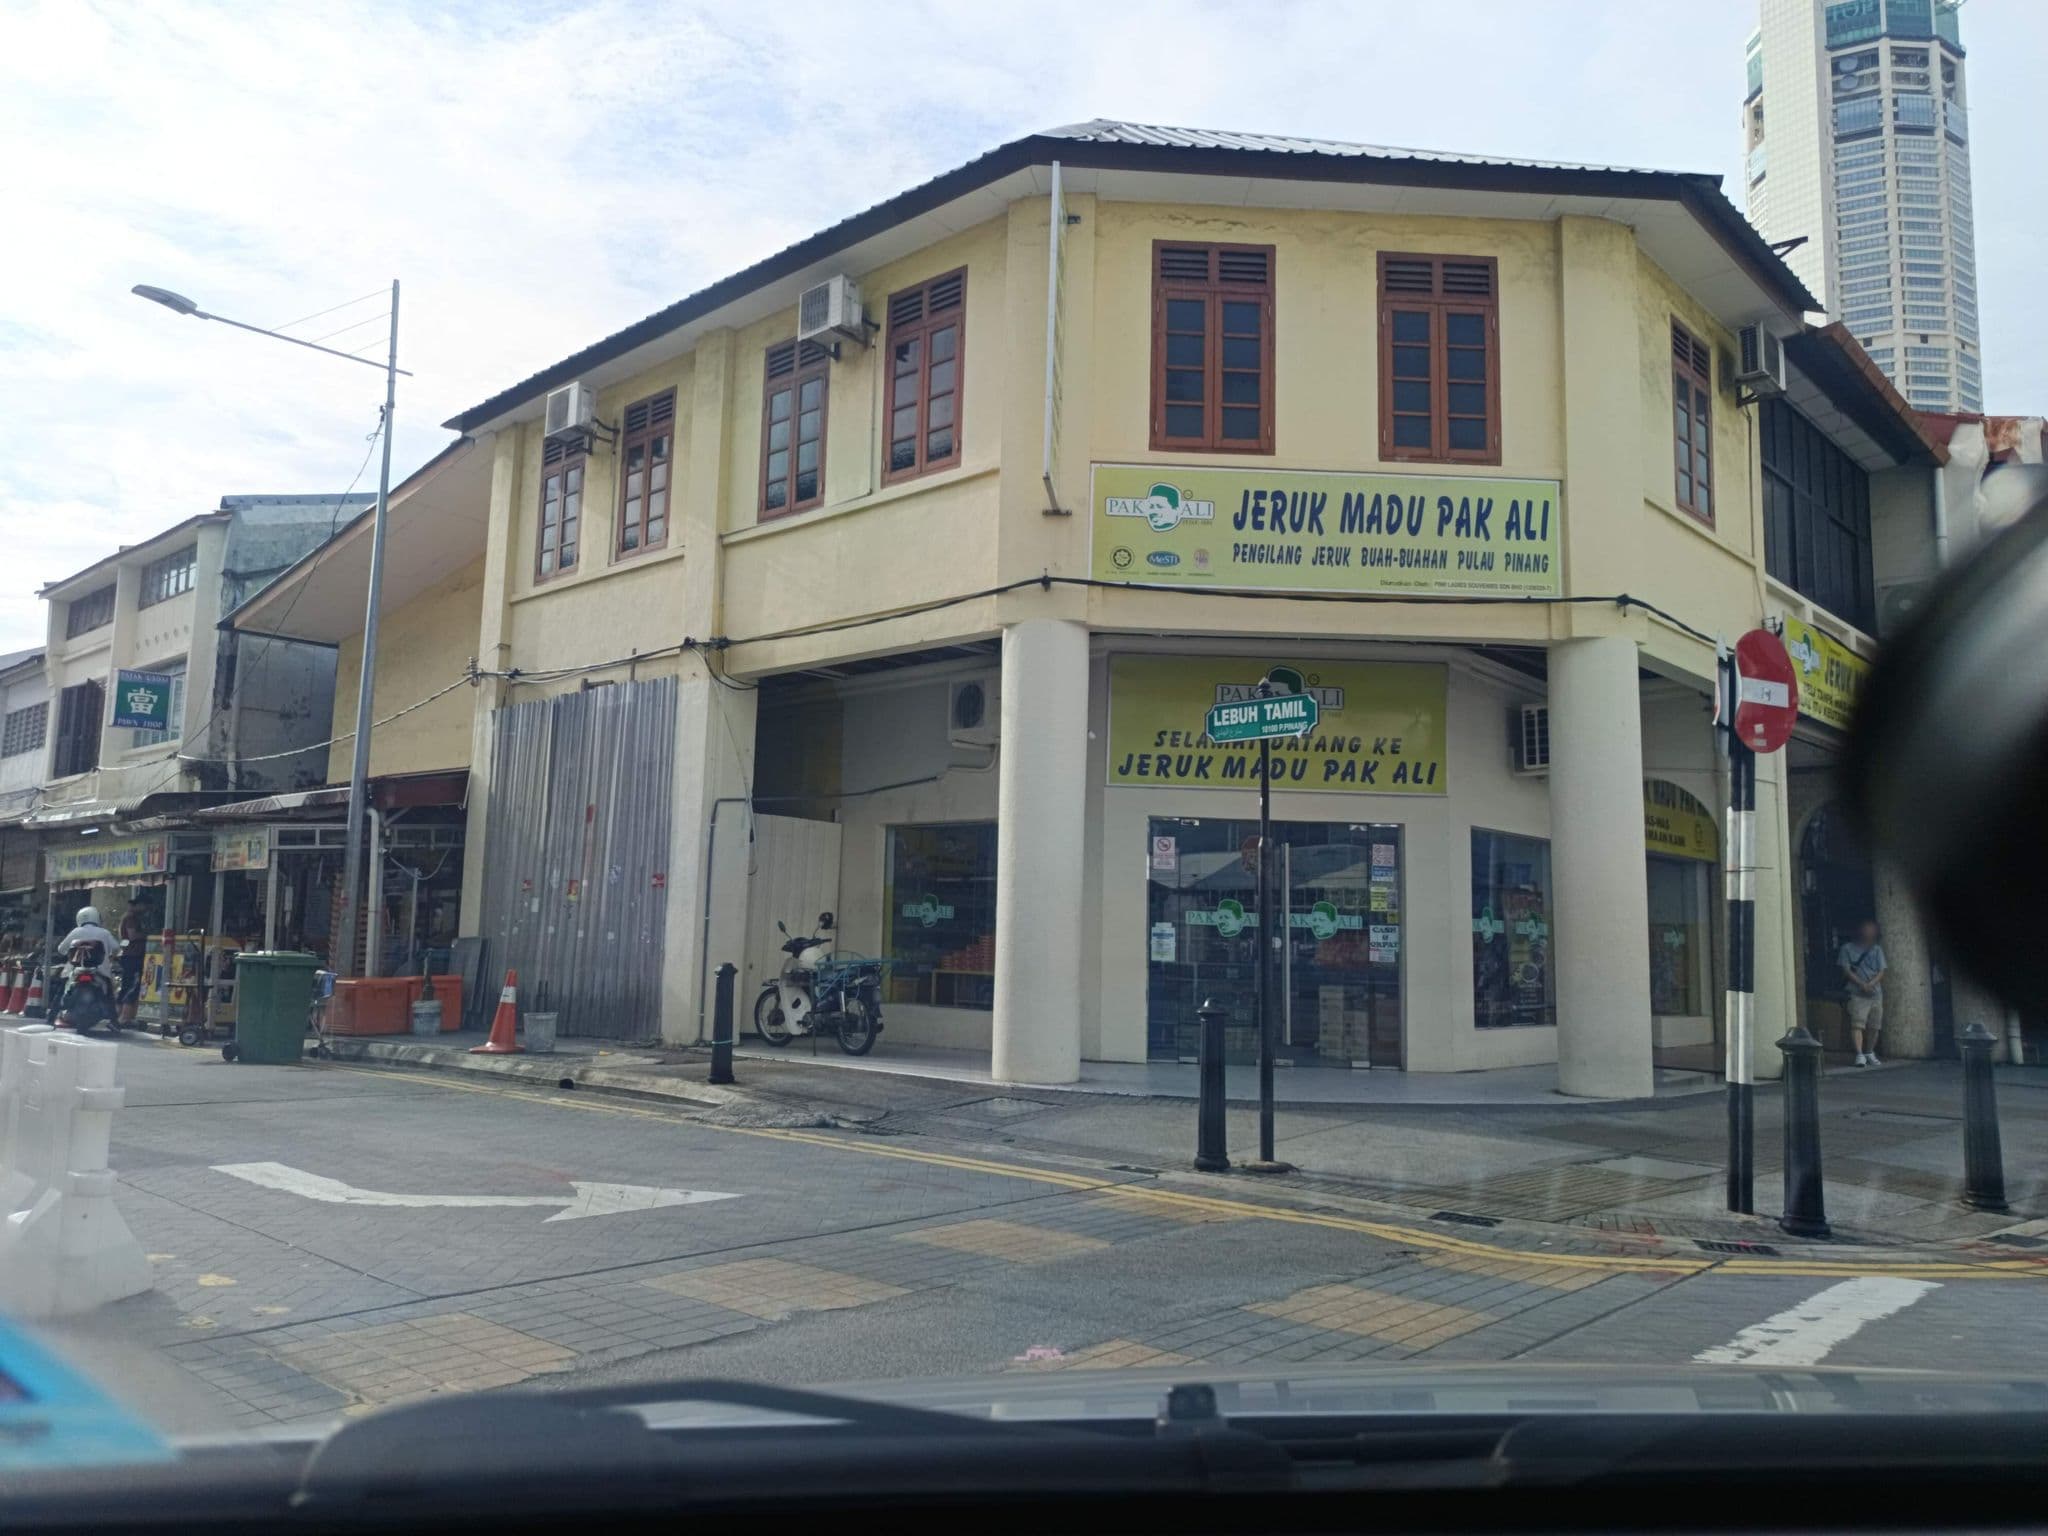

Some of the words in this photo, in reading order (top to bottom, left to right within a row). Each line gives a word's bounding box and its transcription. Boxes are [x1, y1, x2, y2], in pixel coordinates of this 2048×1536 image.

[1109, 499, 1144, 514] PAK
[1181, 502, 1212, 516] ALI
[1233, 489, 1327, 536] JERUK
[1339, 491, 1426, 537] MADU
[1437, 495, 1494, 542] PAK
[1505, 499, 1550, 541] ALI
[1232, 543, 1302, 565] PENGILANG
[1312, 546, 1351, 568] JERUK
[1360, 547, 1448, 569] BUAH-BUAHAN
[1457, 550, 1495, 571] PULAU
[1504, 552, 1549, 573] PINANG
[1213, 705, 1258, 726] LEBUH
[1263, 700, 1307, 720] TAMIL
[1261, 724, 1278, 733] 10100
[1373, 737, 1403, 756] KE
[1118, 753, 1214, 779] JERUK
[1221, 755, 1308, 780] MADU
[1323, 759, 1380, 784] PAK
[1392, 762, 1437, 785] ALI
